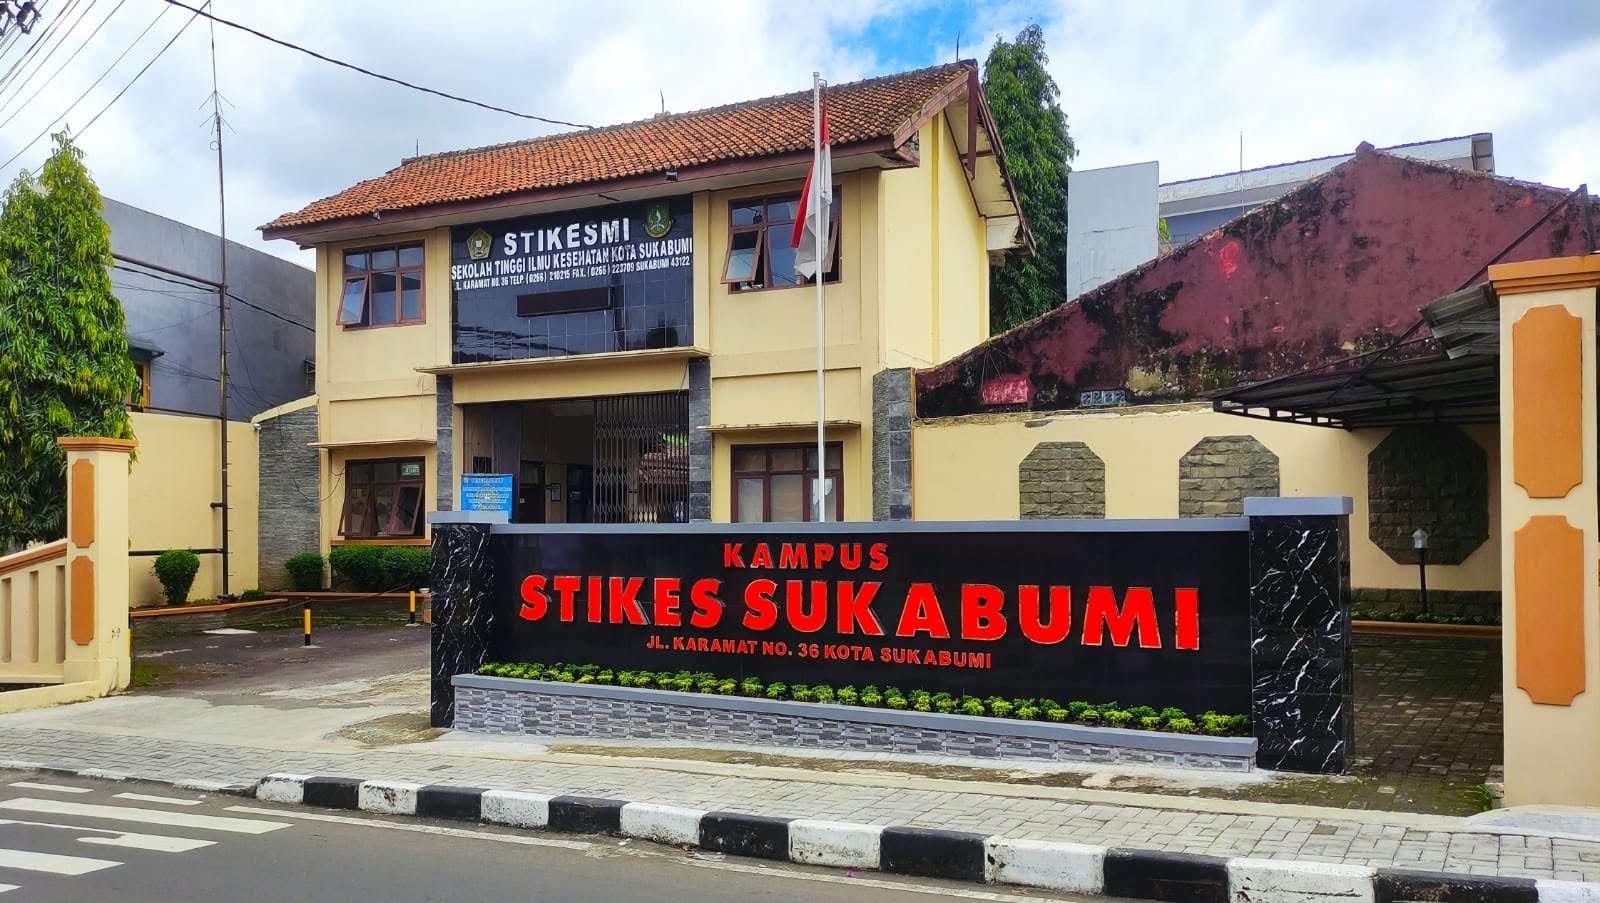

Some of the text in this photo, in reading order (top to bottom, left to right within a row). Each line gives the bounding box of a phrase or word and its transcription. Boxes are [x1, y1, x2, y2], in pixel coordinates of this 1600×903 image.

[504, 218, 629, 256] STIKESMI
[451, 237, 692, 280] SEKOLAH TINGGI ILMU KESEHATAN KOTA SUKABUMI
[463, 278, 490, 290] KARAMAT
[501, 276, 509, 286] 36
[510, 274, 525, 285] TELP.
[572, 267, 586, 279] FAX.
[636, 257, 669, 272] SUKABUMI
[670, 256, 690, 267] 43122
[723, 543, 889, 571] KAMPUS
[519, 574, 1200, 650] STIKES SUKABUMI
[646, 635, 991, 669] JL. KARAMAT NO. 36 KOTA SUKABUMI
